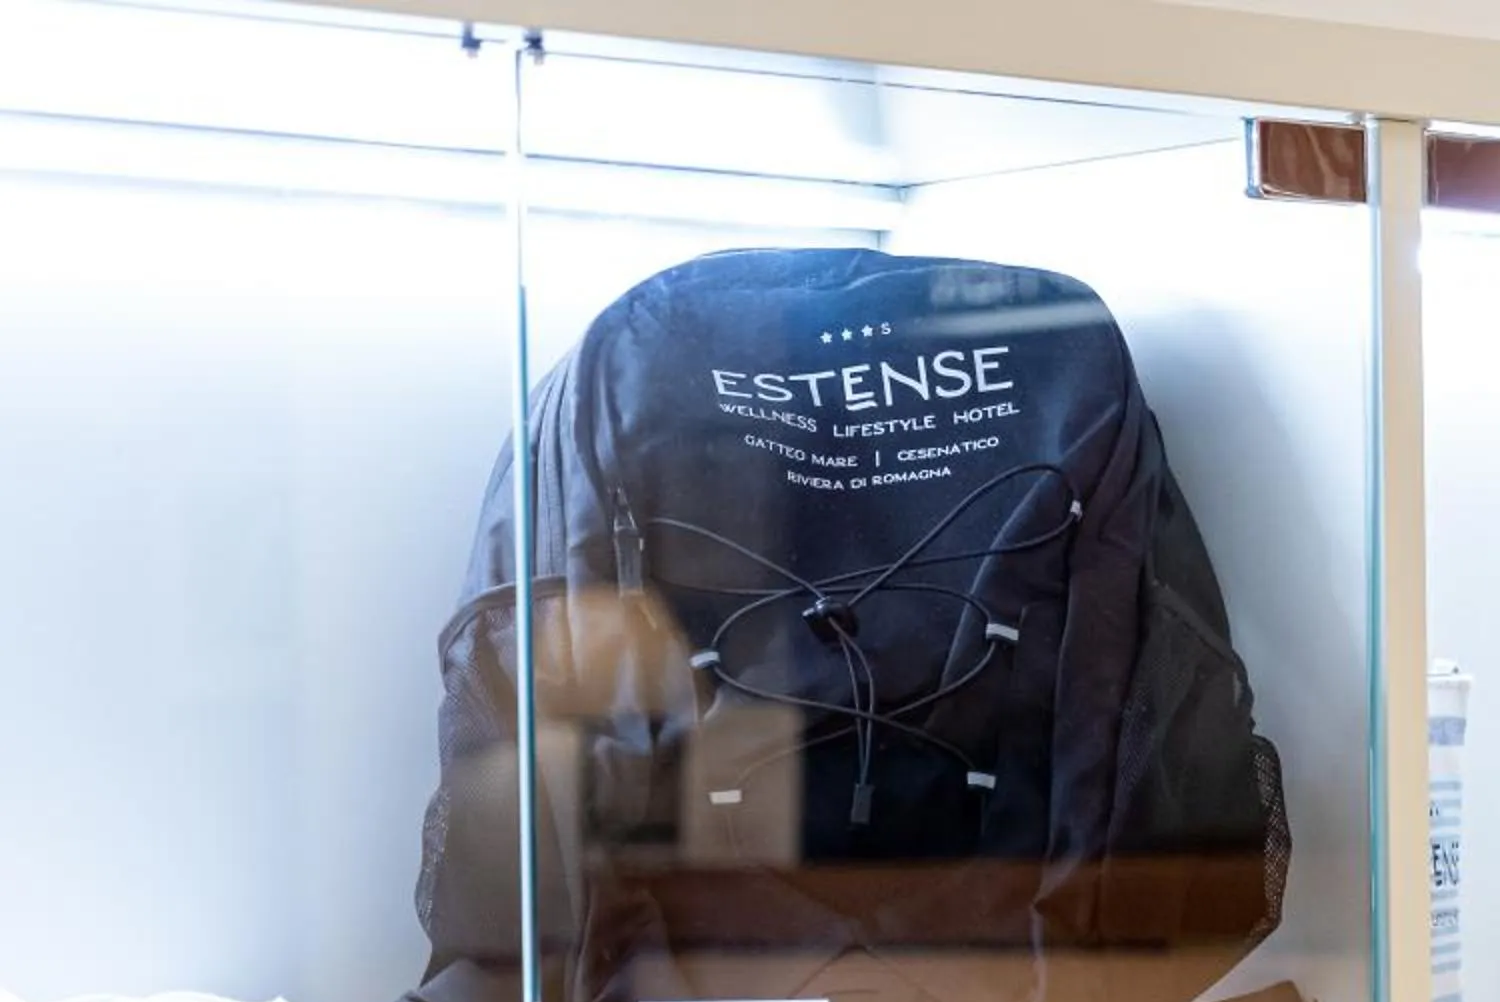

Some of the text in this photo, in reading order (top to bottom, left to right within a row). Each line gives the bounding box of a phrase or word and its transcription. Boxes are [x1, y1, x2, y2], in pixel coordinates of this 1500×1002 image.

[711, 346, 1014, 411] ESTENSE
[719, 401, 1020, 437] WELLNESS LIFESTYLE HOTEL
[744, 434, 805, 461] GATTEO
[811, 453, 858, 467] MARE
[897, 436, 999, 461] CESENATICO
[787, 466, 952, 490] RIVIERA DI ROMAGNA
